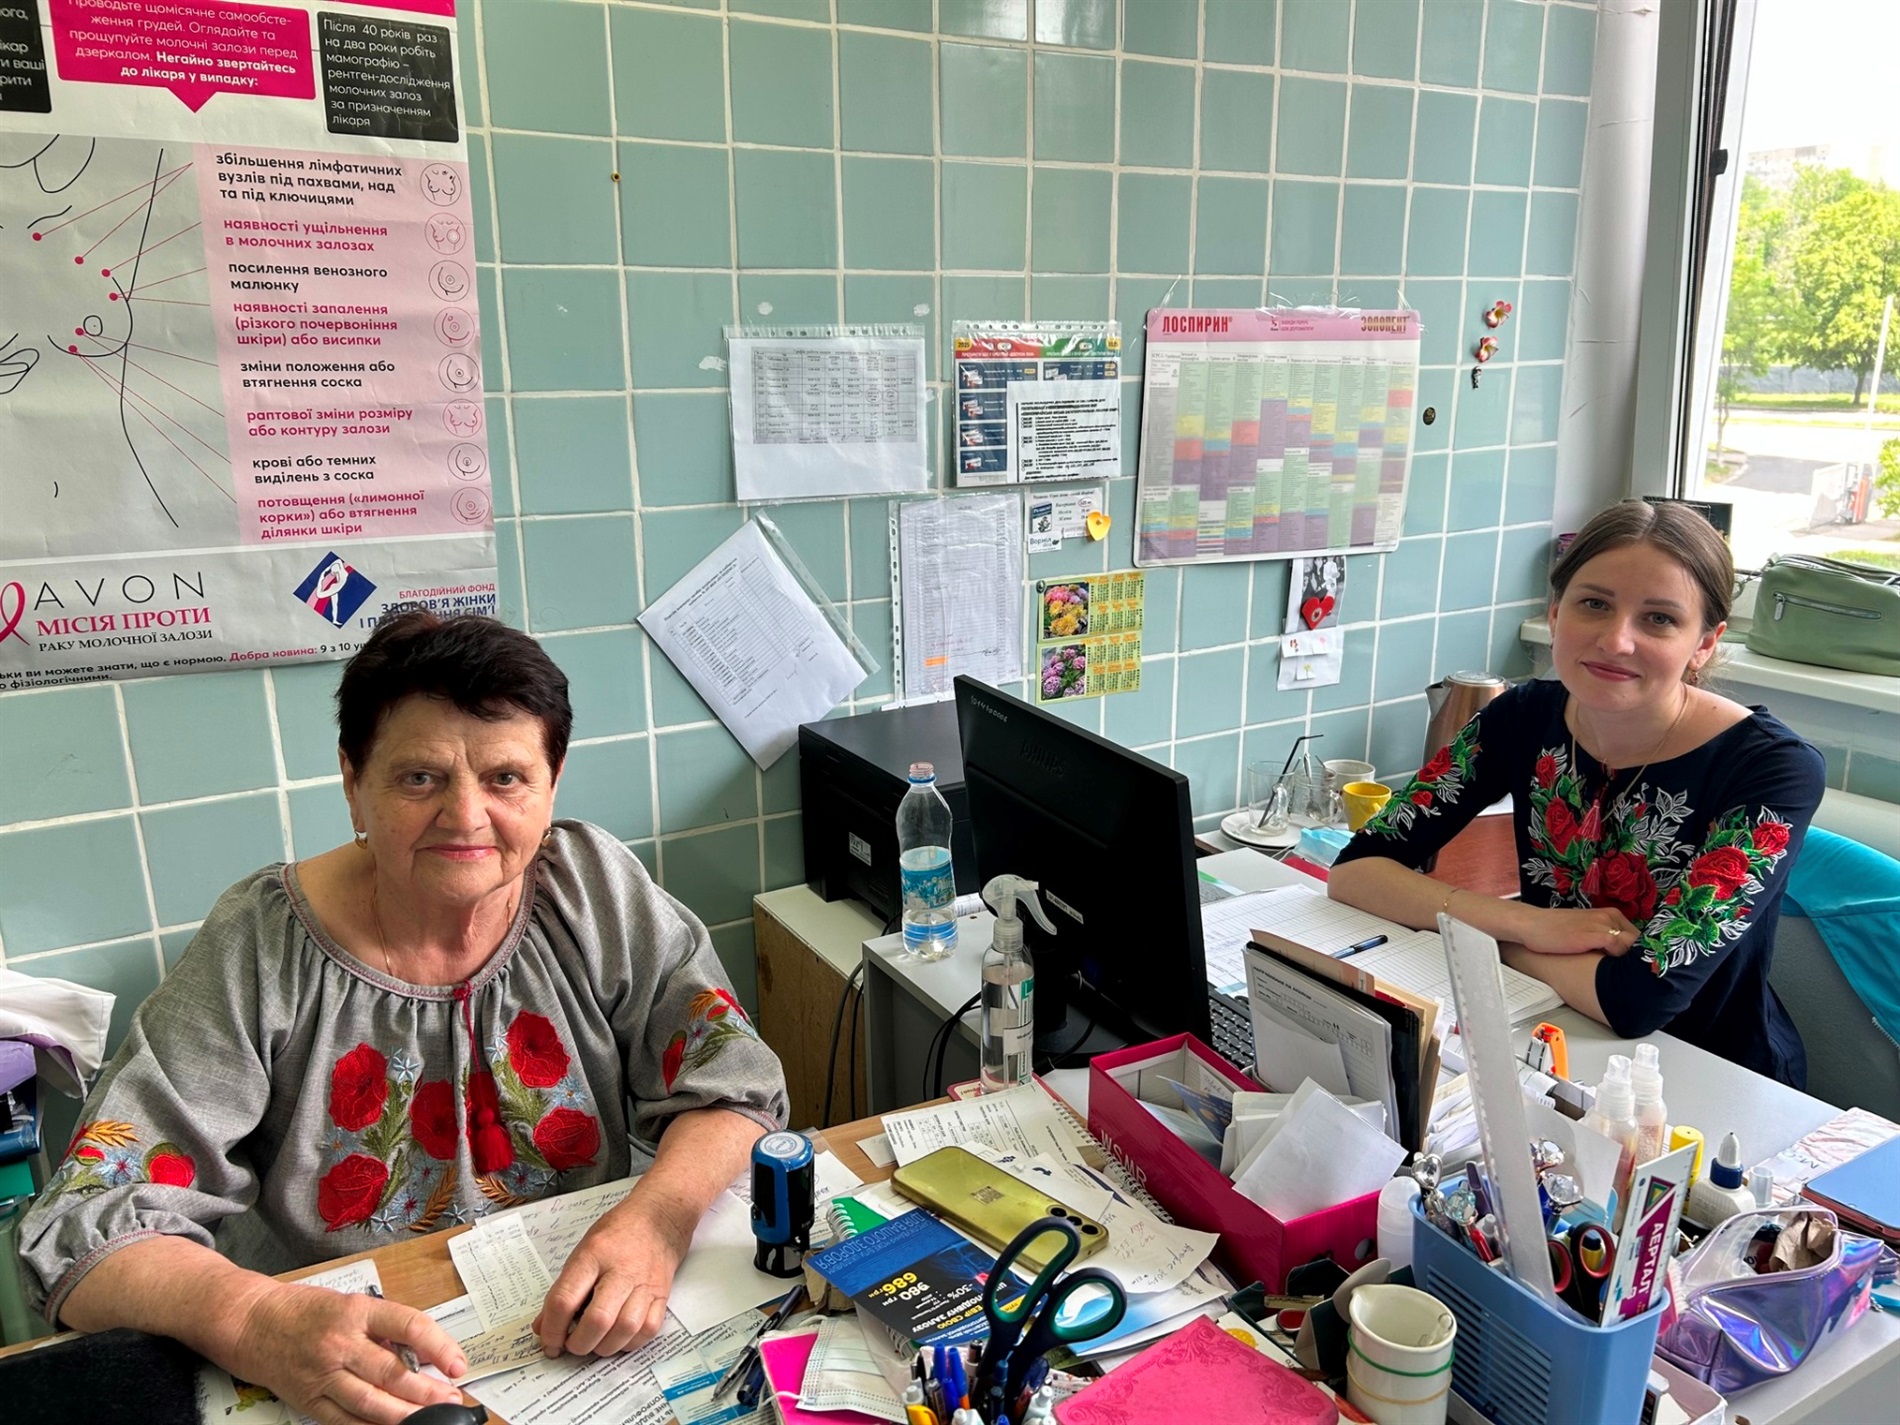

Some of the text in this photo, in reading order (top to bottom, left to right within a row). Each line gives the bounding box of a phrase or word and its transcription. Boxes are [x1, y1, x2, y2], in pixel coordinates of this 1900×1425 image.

[69, 0, 292, 26] Проводьте щомісячне самообсте-
[91, 15, 276, 41] ження грудей. Оглядайте та
[323, 18, 438, 44] Після 40 років раз
[69, 30, 299, 60] прощупуйте молочні залози перед
[325, 38, 436, 59] на два роки робіть
[12, 59, 45, 70] ваші
[75, 46, 296, 75] дзеркалом. Негайно звертайтесь
[326, 54, 400, 70] мамографію
[120, 66, 259, 88] до лікаря у випадку:
[328, 69, 451, 90] рентген-дослідження
[329, 85, 423, 102] молочних залоз
[331, 101, 432, 118] за призначенням
[332, 114, 371, 127] лікаря
[216, 152, 402, 177] збільшення лімфатичних
[218, 171, 396, 194] вузлів під пахвами, над
[219, 188, 355, 206] та під ключицями
[224, 219, 388, 237] наявності ущільнення
[225, 236, 375, 252] в молочних залозах
[229, 263, 388, 278] посилення венозного
[230, 280, 299, 294] малюнку
[234, 302, 388, 315] наявності запалення
[235, 316, 398, 332] (різкого почервоніння
[237, 333, 381, 348] шкіри) або висипки
[240, 360, 396, 373] зміни положення або
[242, 378, 363, 388] втягнення соска
[247, 408, 413, 424] раптової зміни розміру
[248, 424, 391, 437] або контуру залози
[253, 455, 377, 471] крові або темних
[255, 470, 375, 485] виділень з соска
[258, 490, 425, 509] потовщення («лимонної
[259, 507, 418, 525] корки») або втягнення
[261, 523, 363, 540] ділянки шкіри
[34, 571, 205, 611] AVON
[399, 583, 496, 600] БЛАГОДІЙНИЙ ФОНД
[452, 593, 496, 608] ЖІНКИ
[35, 607, 212, 637] МІСІЯ ПРОТИ
[39, 630, 213, 652] РАКУ МОЛОЧНОЇ ЗАЛОЗИ
[26, 670, 42, 678] ви
[45, 665, 94, 676] можете
[97, 662, 138, 673] знати,
[140, 660, 160, 670] що
[163, 659, 171, 667] є
[173, 655, 227, 667] нормою.
[230, 649, 269, 663] Добра
[272, 646, 318, 659] новина:
[320, 644, 328, 655] 9
[330, 645, 336, 653] з
[339, 642, 351, 653] 10
[10, 674, 113, 690] фізіологічними.
[1020, 738, 1067, 777] PHILIPS
[815, 1212, 925, 1270] ДЛЯ ВАШОГО ЗДОРОВ’Я
[1638, 1223, 1664, 1294] АЕРТАЛ
[882, 1282, 930, 1307] 980 грн
[947, 1283, 973, 1300] -30%
[912, 1314, 947, 1333] ЗАЛОЗУ
[936, 1315, 964, 1330] СВОЮ
